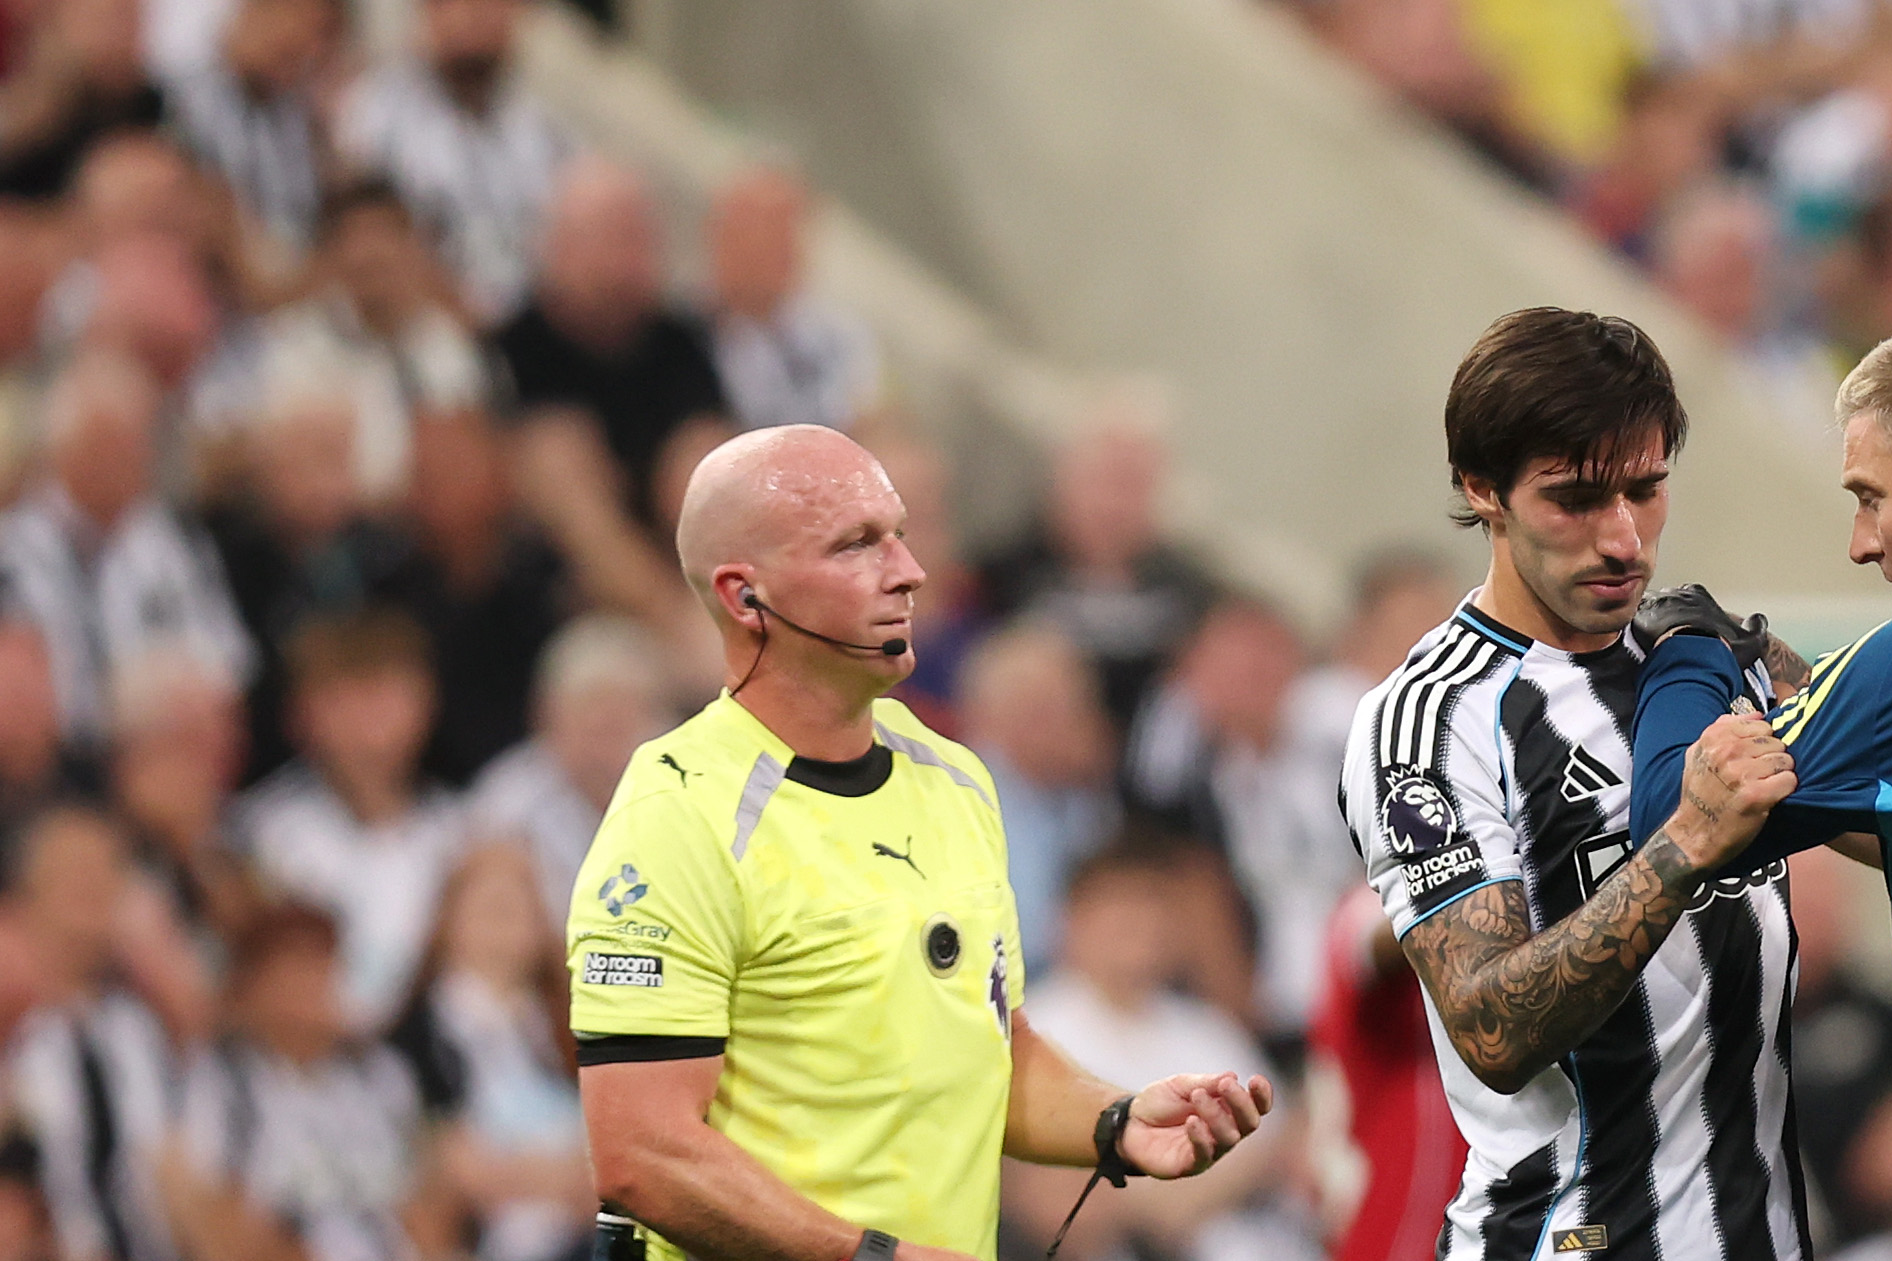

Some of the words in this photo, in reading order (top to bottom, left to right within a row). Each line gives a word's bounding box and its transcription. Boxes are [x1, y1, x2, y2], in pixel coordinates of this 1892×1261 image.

[1401, 864, 1423, 882] No
[1422, 846, 1473, 875] room
[1406, 878, 1425, 899] for
[1426, 858, 1484, 890] racism
[585, 952, 608, 970] No
[608, 956, 657, 973] room
